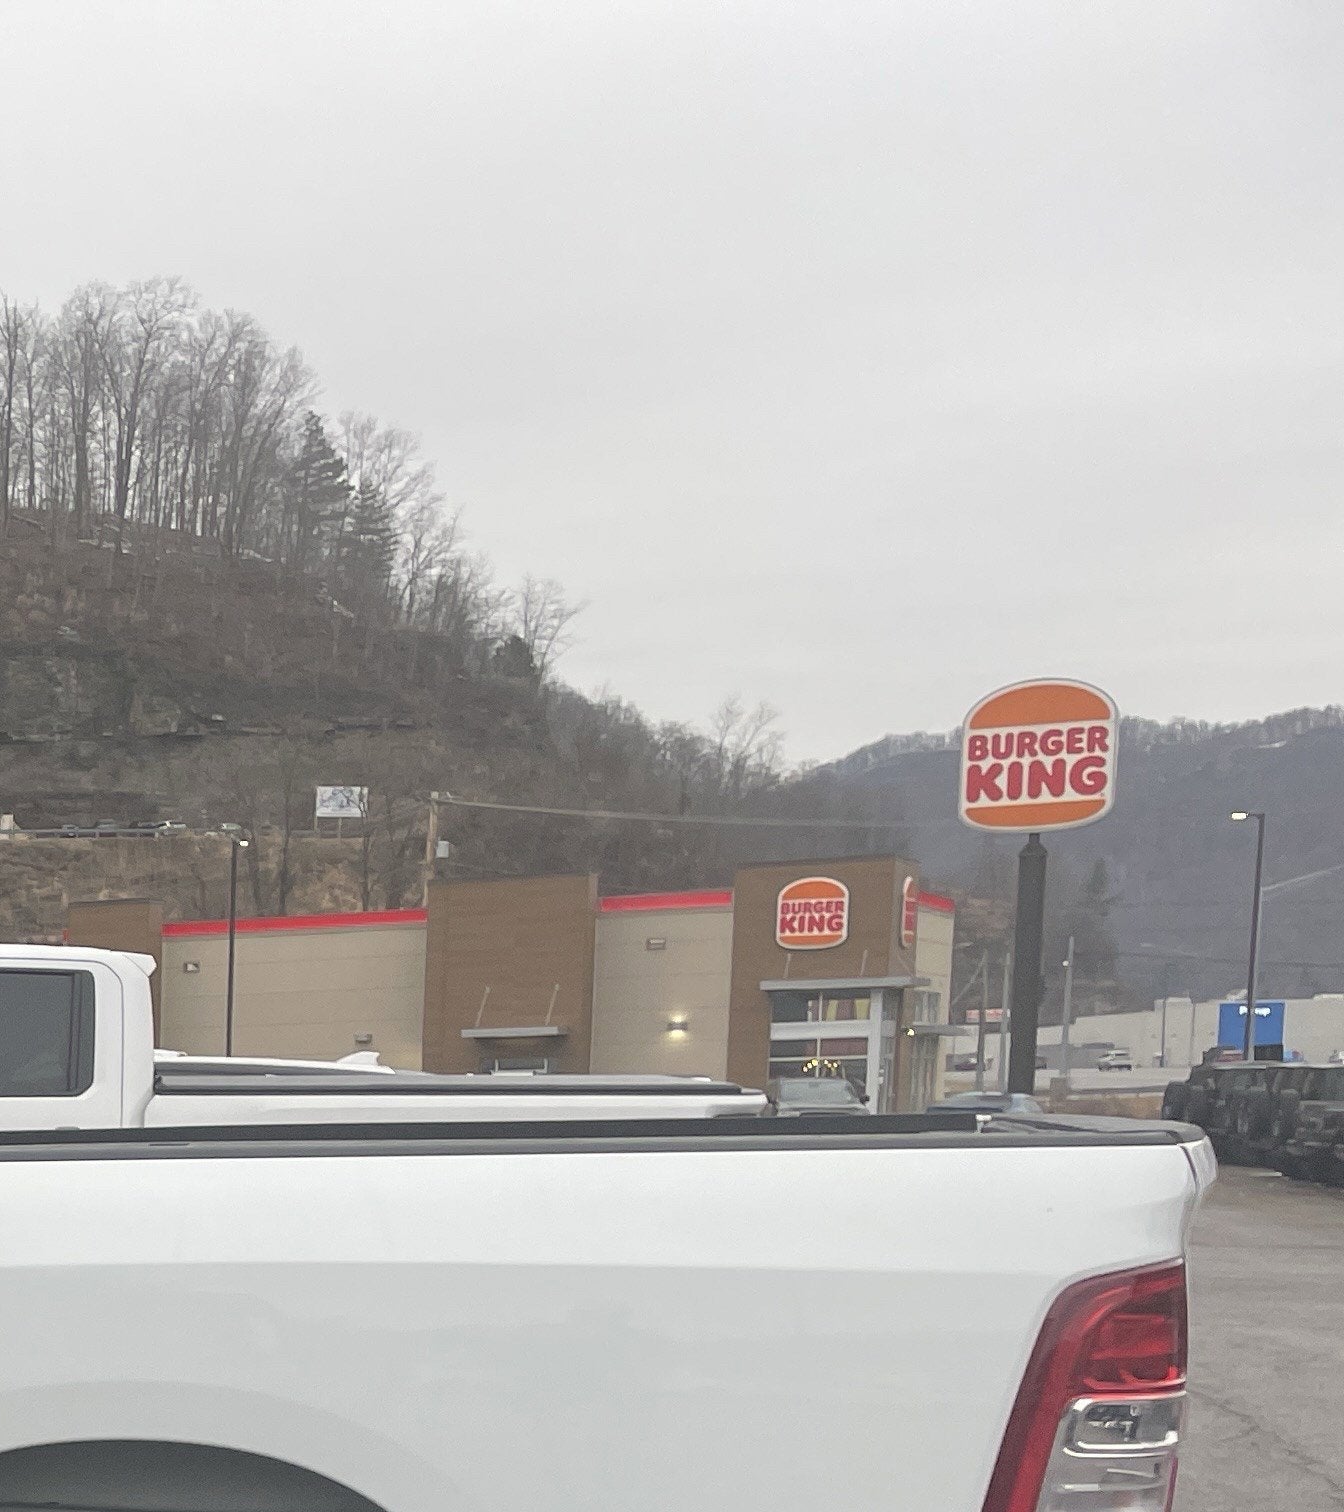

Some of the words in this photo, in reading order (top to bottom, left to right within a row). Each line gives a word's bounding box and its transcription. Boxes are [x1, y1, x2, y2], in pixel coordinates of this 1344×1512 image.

[968, 726, 1109, 762] BURGER
[966, 756, 1108, 803] KING
[780, 900, 845, 914] BURGER
[779, 914, 844, 934] KING
